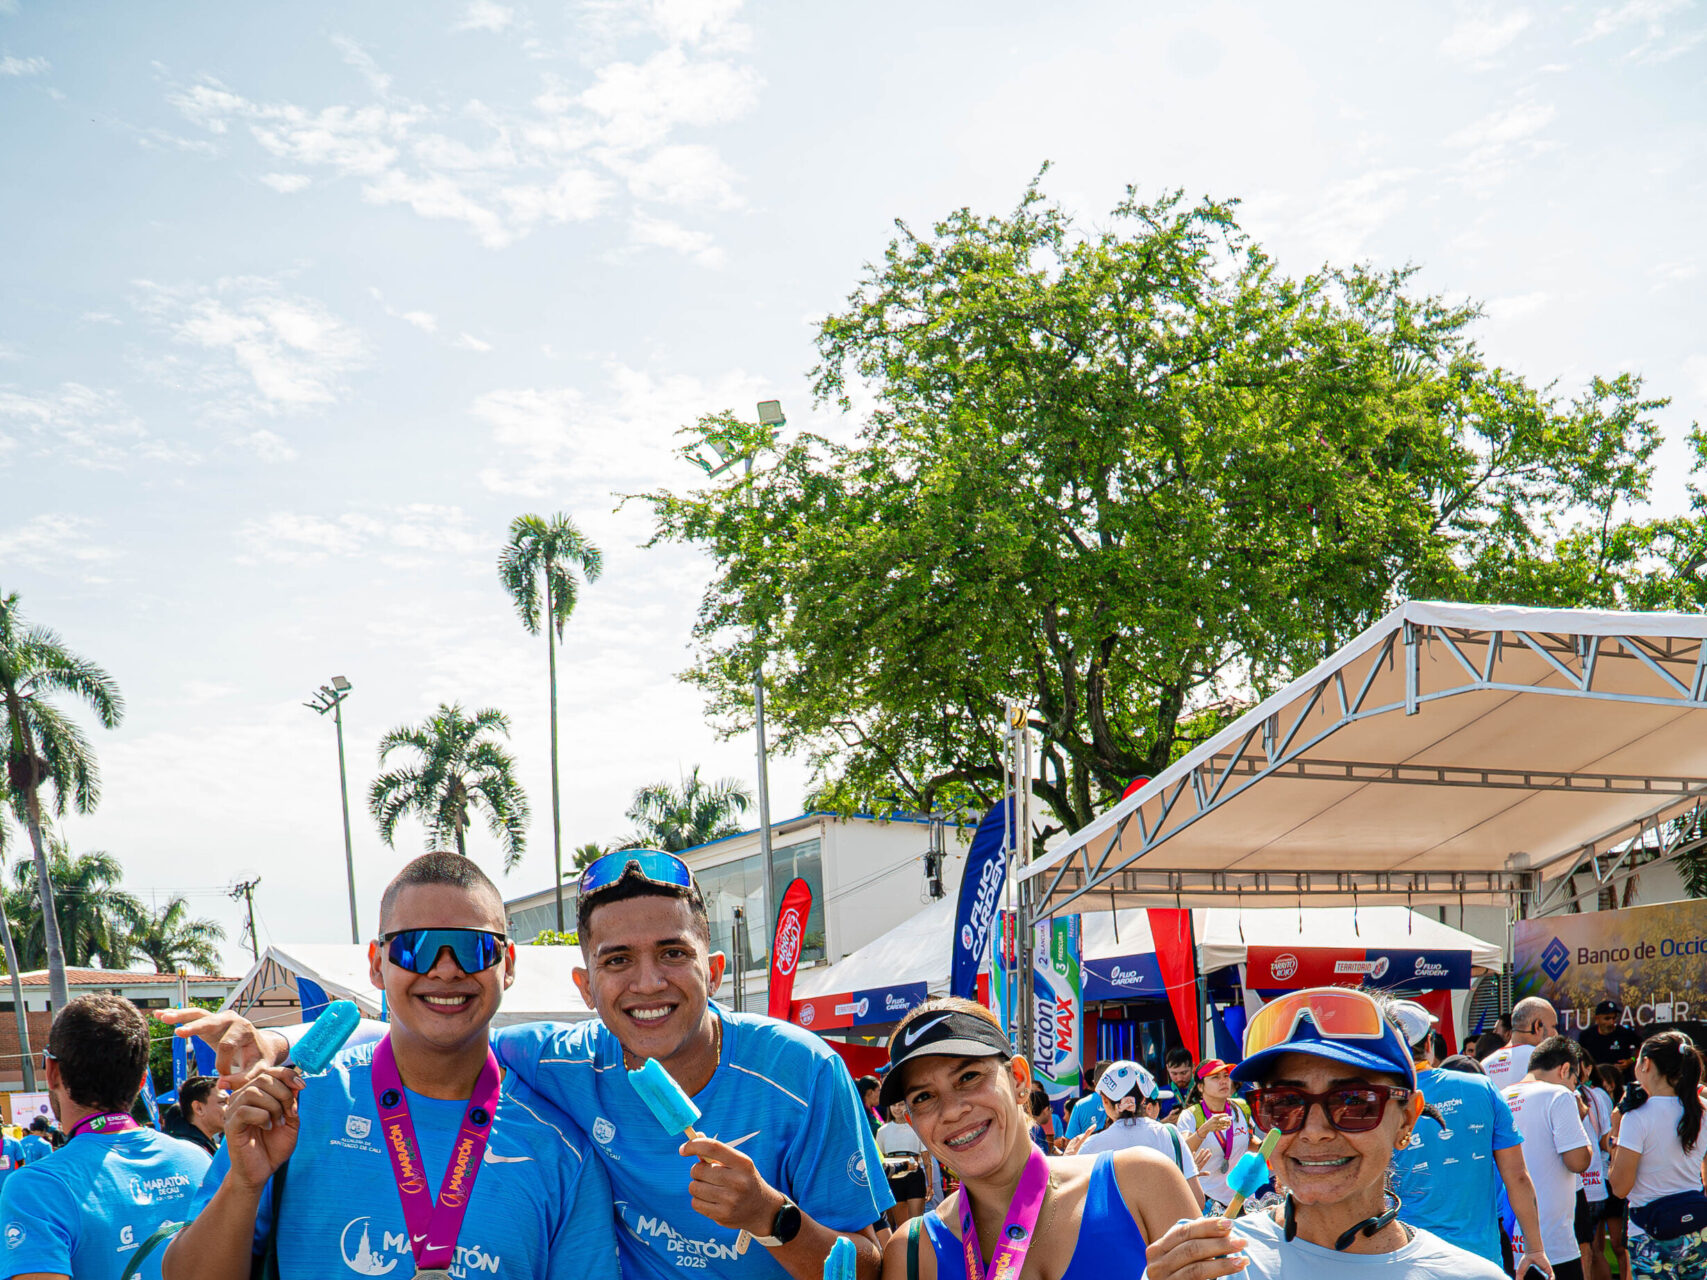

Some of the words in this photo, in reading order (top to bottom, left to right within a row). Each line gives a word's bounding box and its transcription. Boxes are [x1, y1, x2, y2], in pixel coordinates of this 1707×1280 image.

[970, 858, 994, 928] FLUO
[1577, 947, 1630, 965] Banco
[1634, 941, 1656, 960] de
[1039, 956, 1048, 965] 2
[1056, 963, 1066, 976] 3
[1119, 970, 1137, 979] FLUO
[1414, 968, 1448, 976] CARDENT
[1111, 976, 1144, 986] CARDENT
[1056, 995, 1073, 1053] MAX
[1560, 1008, 1591, 1031] TU
[1033, 999, 1056, 1080] Acción
[1434, 1098, 1463, 1109] ARATÓN
[329, 1139, 359, 1149] SANTIAGO
[389, 1124, 414, 1178] MARATÓN
[448, 1138, 475, 1191] MARATÓN
[142, 1172, 190, 1192] MARATÓN
[166, 1186, 180, 1194] CALI
[667, 1239, 685, 1252] DE
[675, 1255, 707, 1268] 2025
